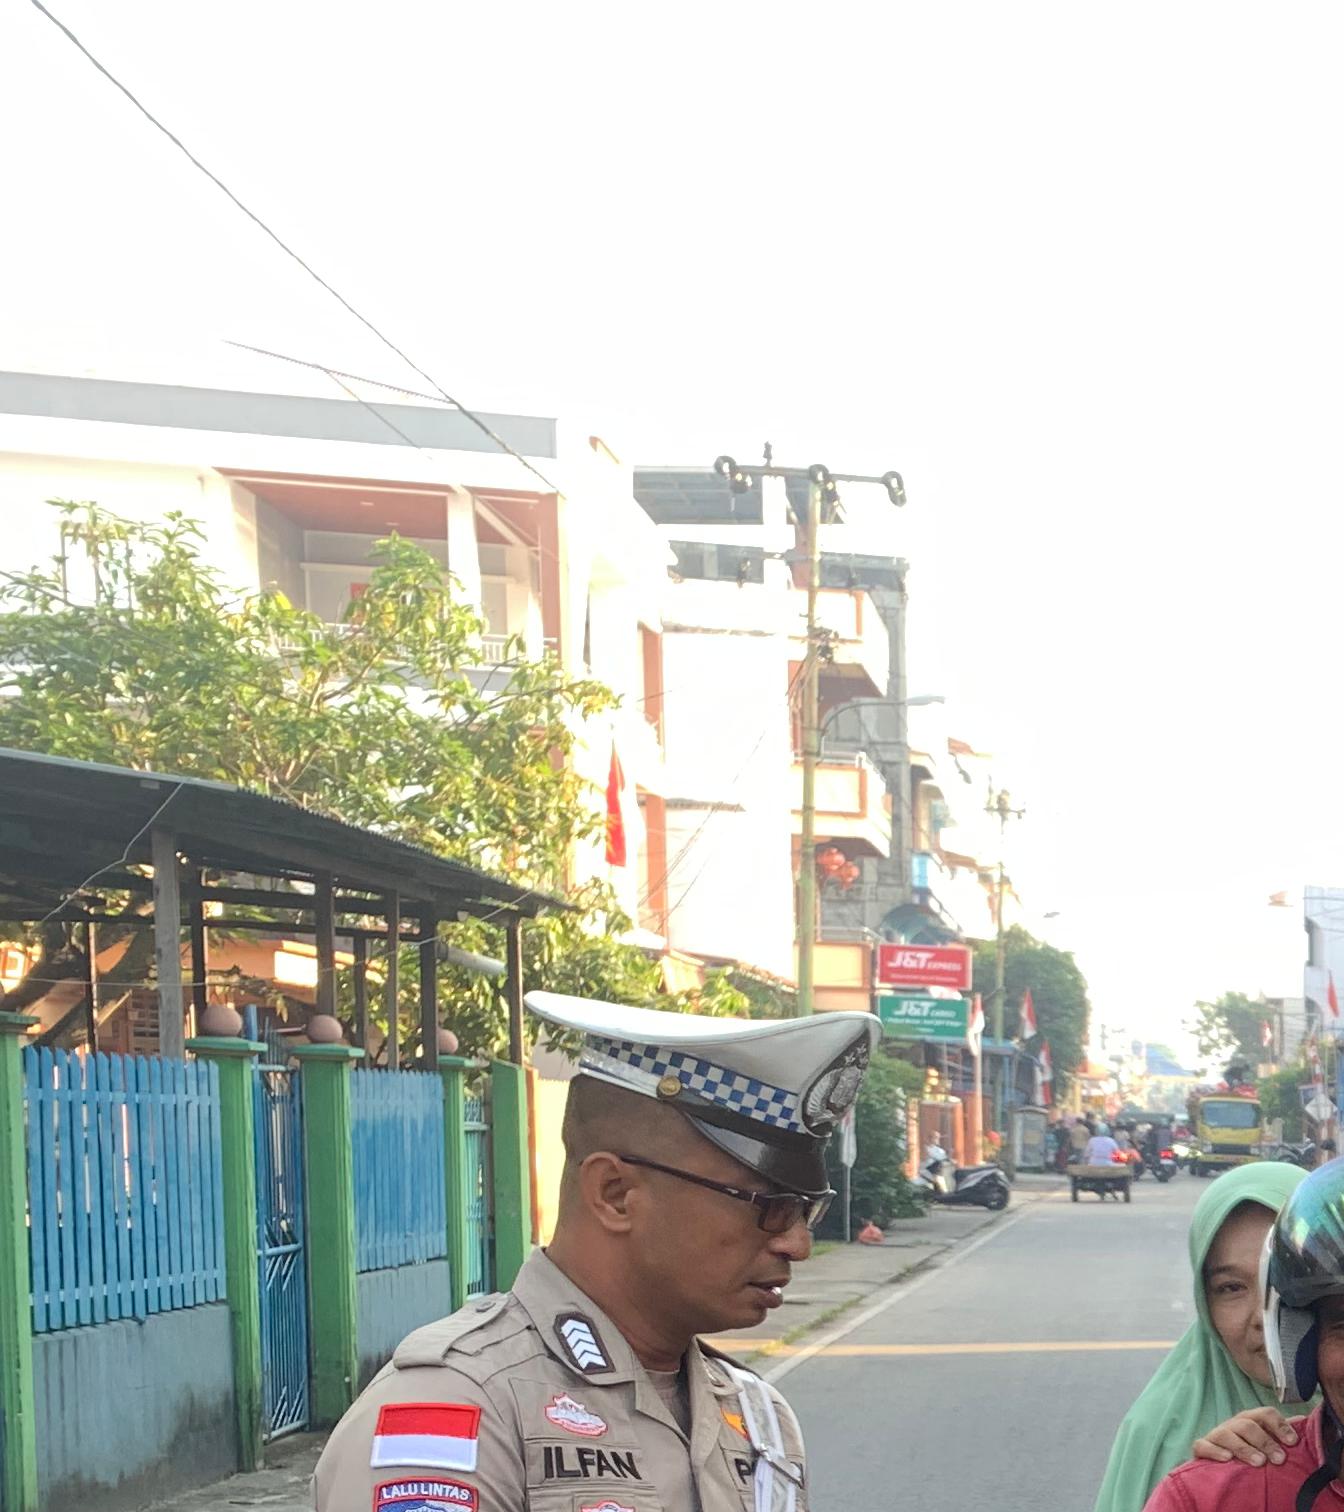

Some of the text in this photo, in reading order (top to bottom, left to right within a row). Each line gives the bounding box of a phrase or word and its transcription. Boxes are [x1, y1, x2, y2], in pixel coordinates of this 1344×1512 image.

[888, 950, 936, 969] J&T
[893, 1000, 938, 1017] J&T
[543, 1446, 643, 1480] ILFAN
[382, 1482, 471, 1501] LALU LINTAS
